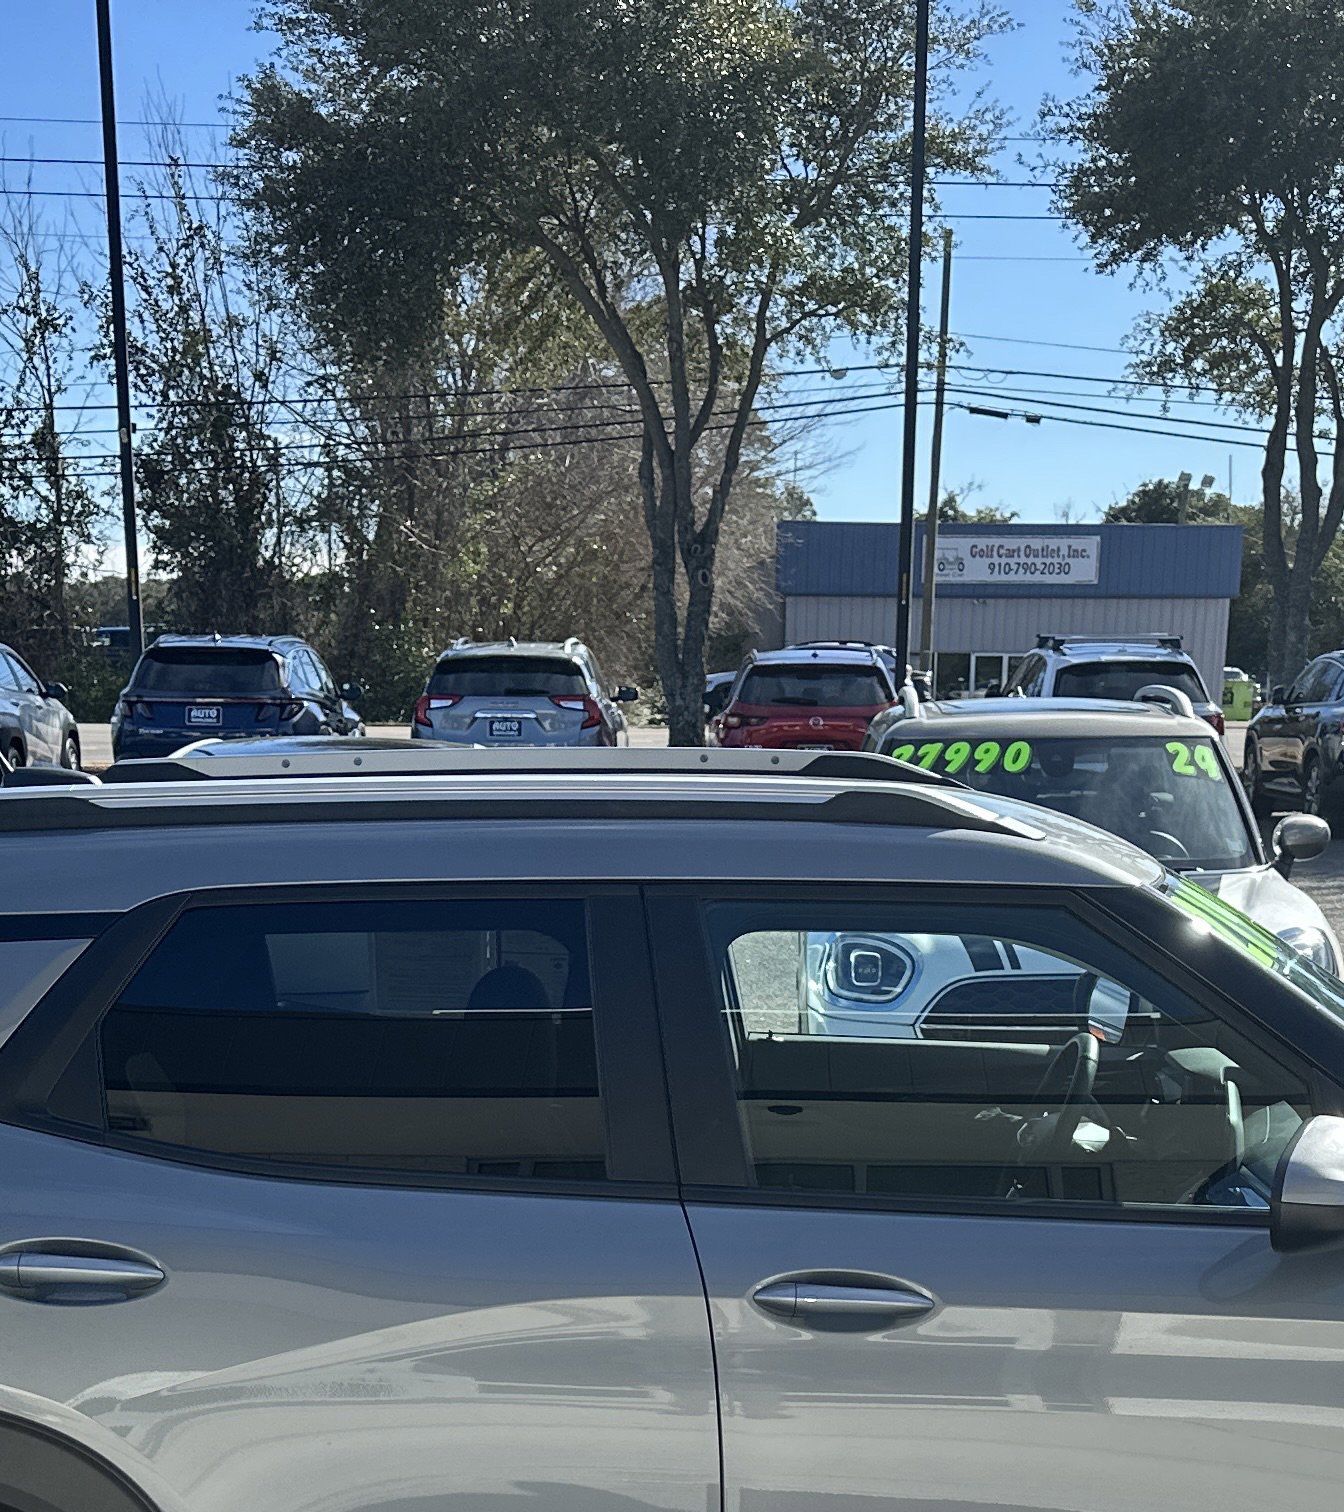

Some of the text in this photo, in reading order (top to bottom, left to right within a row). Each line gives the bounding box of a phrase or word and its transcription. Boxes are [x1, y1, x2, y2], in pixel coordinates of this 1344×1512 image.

[969, 544, 995, 559] Golf
[996, 544, 1021, 559] Cart
[987, 561, 1072, 576] 910-790-2030
[191, 708, 218, 719] AUTO
